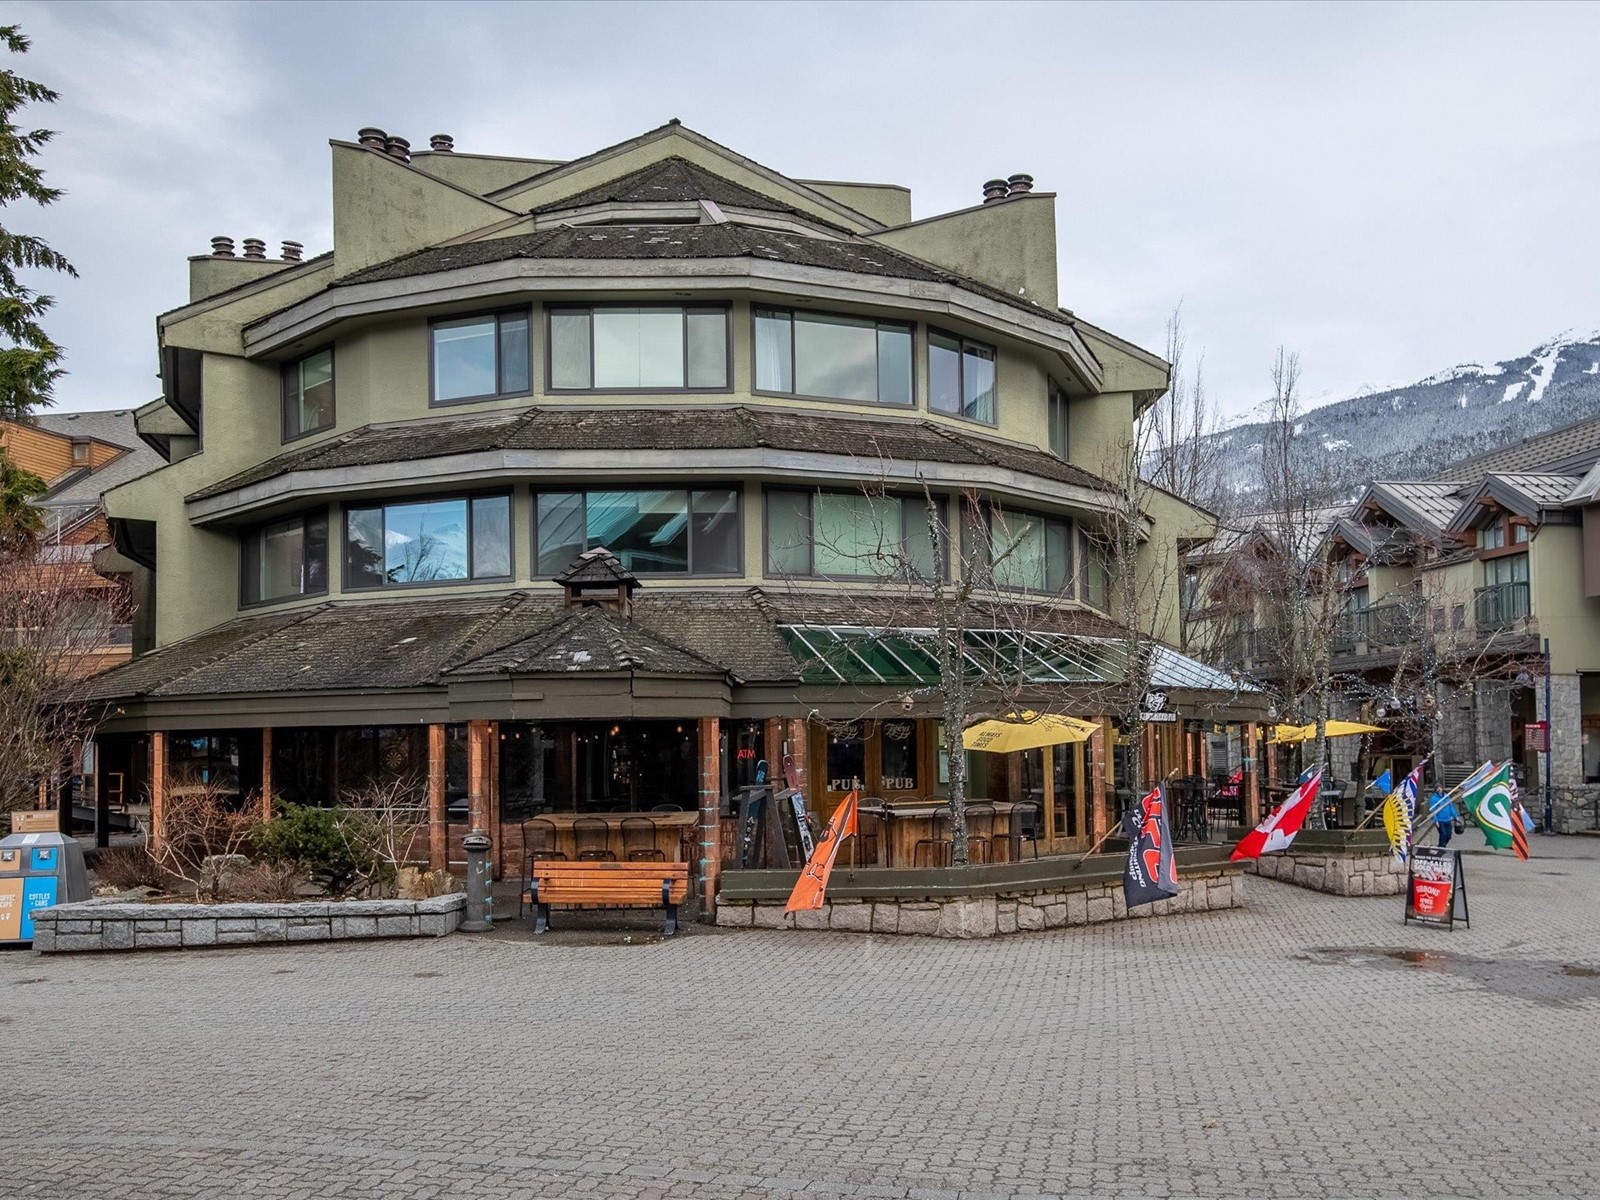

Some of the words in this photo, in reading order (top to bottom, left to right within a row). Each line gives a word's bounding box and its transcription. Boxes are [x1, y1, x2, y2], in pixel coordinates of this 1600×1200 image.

[970, 741, 989, 749] TIMES
[737, 749, 756, 759] ATM
[886, 777, 914, 789] PUB
[1480, 784, 1513, 832] G
[29, 893, 51, 901] BOTTLES
